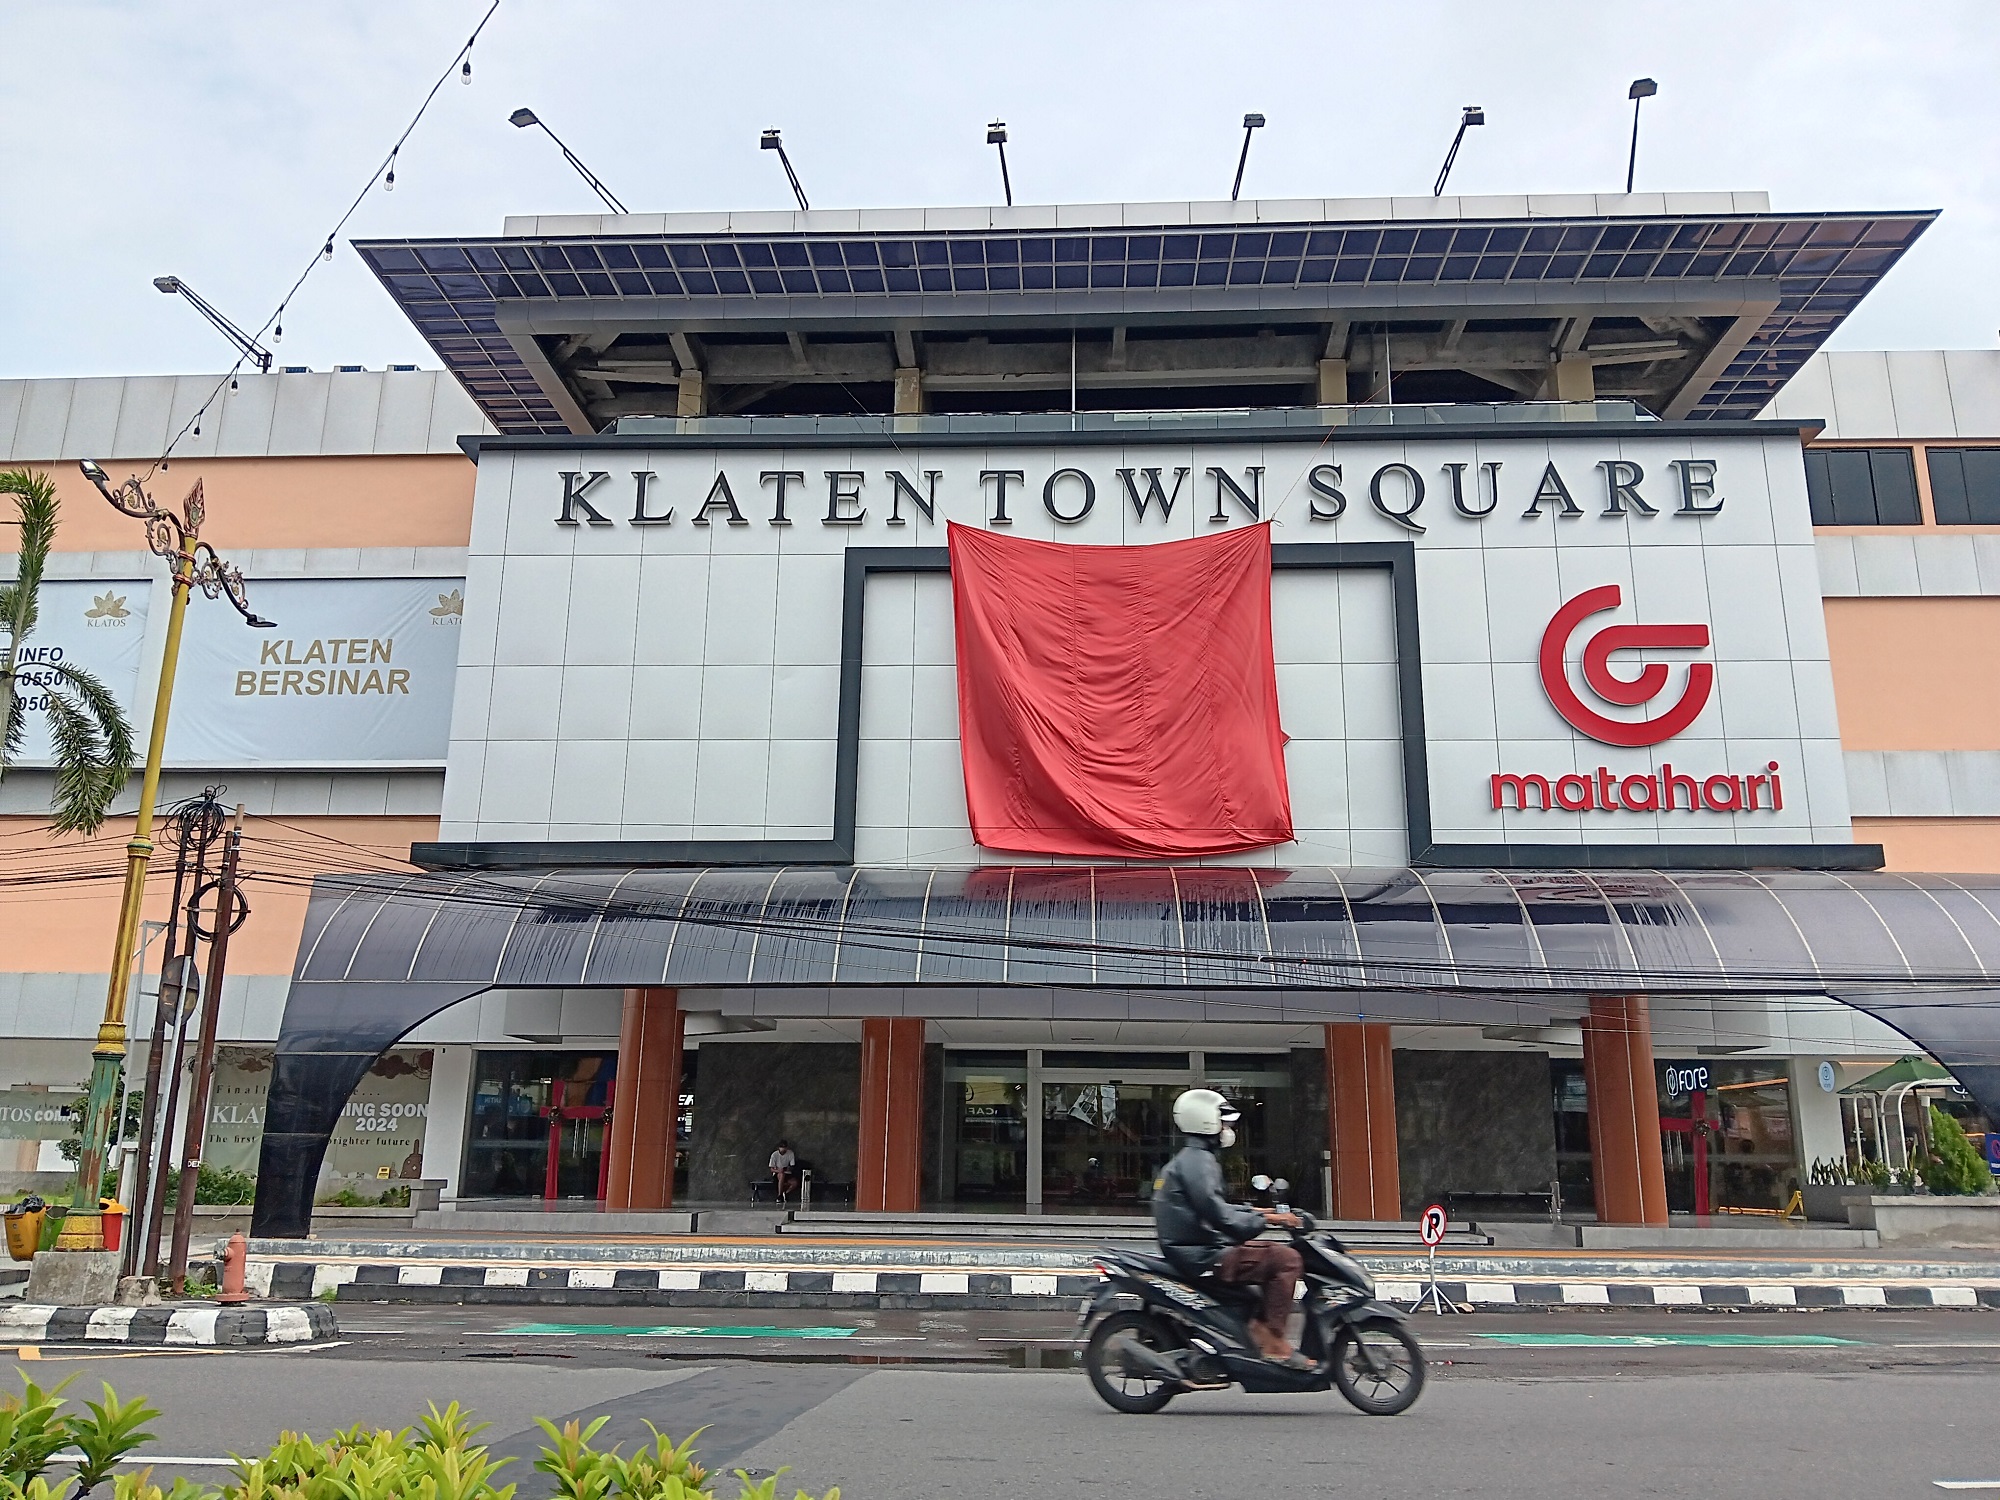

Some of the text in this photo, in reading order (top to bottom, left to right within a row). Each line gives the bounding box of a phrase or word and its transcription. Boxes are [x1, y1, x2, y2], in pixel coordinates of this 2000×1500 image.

[554, 459, 1725, 533] KLATEN TOWN SQUARE
[87, 619, 126, 628] KLATOS
[18, 647, 64, 662] INFO
[260, 638, 393, 665] KLATEN
[235, 669, 410, 696] BERSINAR
[1490, 760, 1783, 812] matahari
[380, 1103, 429, 1118] SOON
[355, 1117, 398, 1132] 2024
[209, 1134, 256, 1143] The first
[376, 1137, 410, 1146] future
